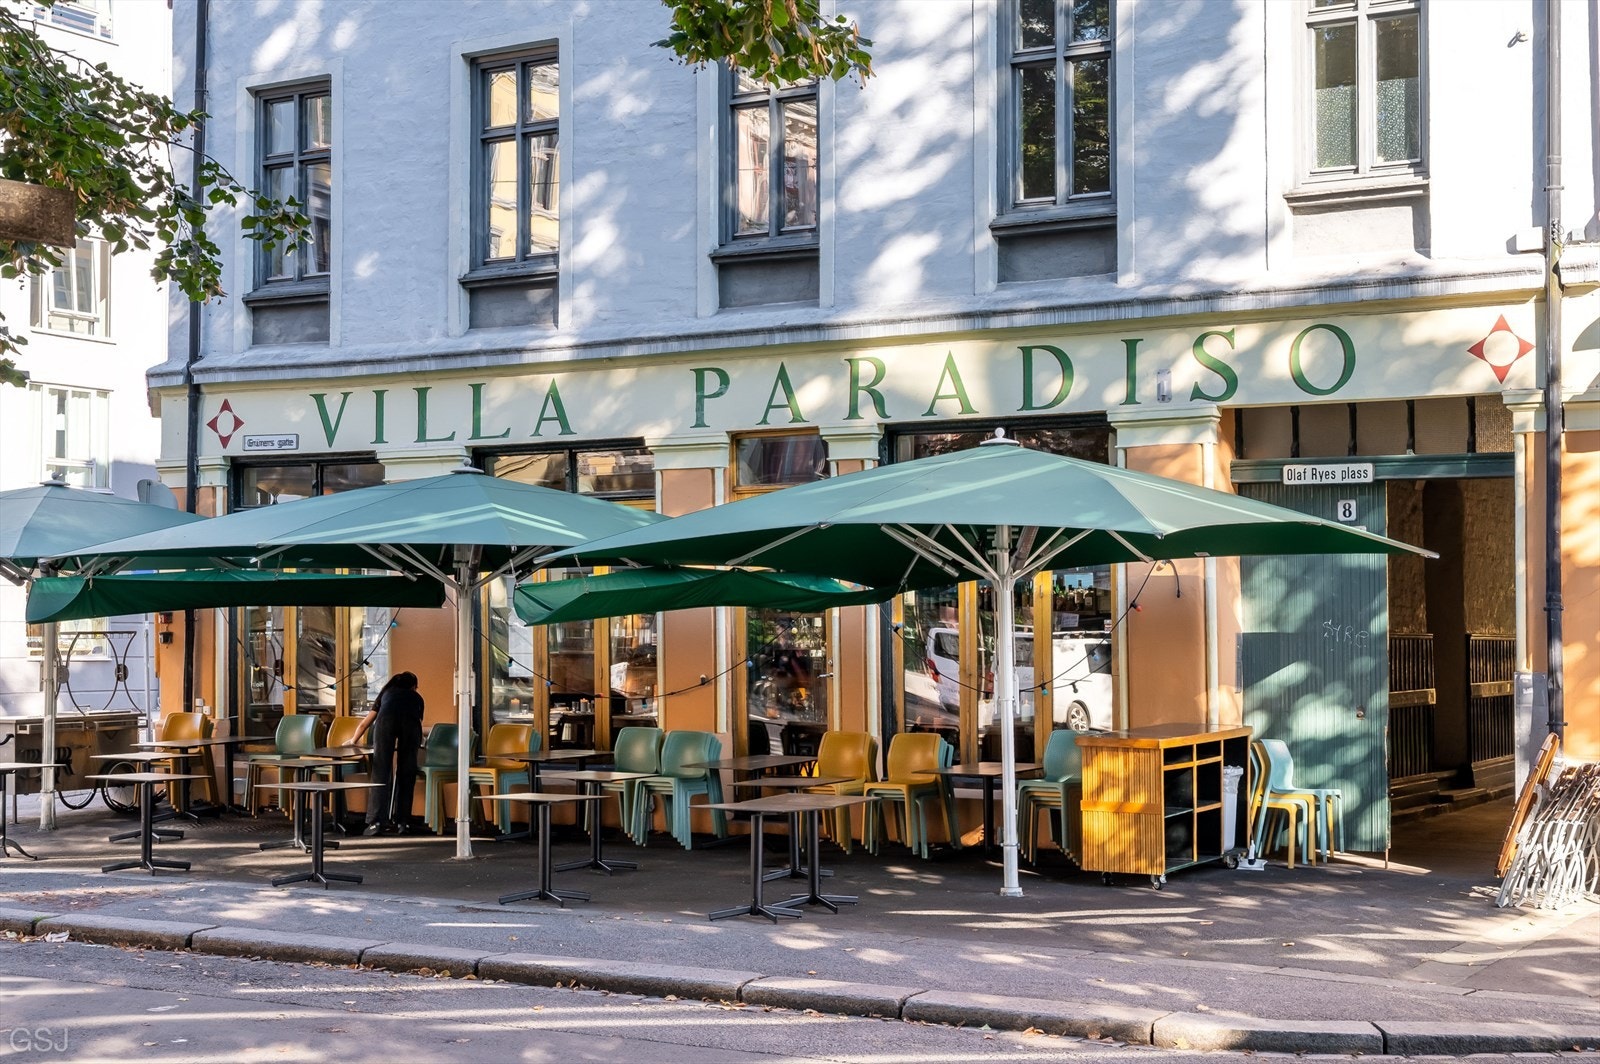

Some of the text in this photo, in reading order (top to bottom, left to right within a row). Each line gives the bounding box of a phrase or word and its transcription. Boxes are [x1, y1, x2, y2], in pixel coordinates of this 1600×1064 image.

[309, 323, 1357, 448] VILLA PARADISO
[277, 438, 294, 448] gate
[1287, 467, 1368, 482] Olaf Ryes plass
[1342, 502, 1353, 518] 8
